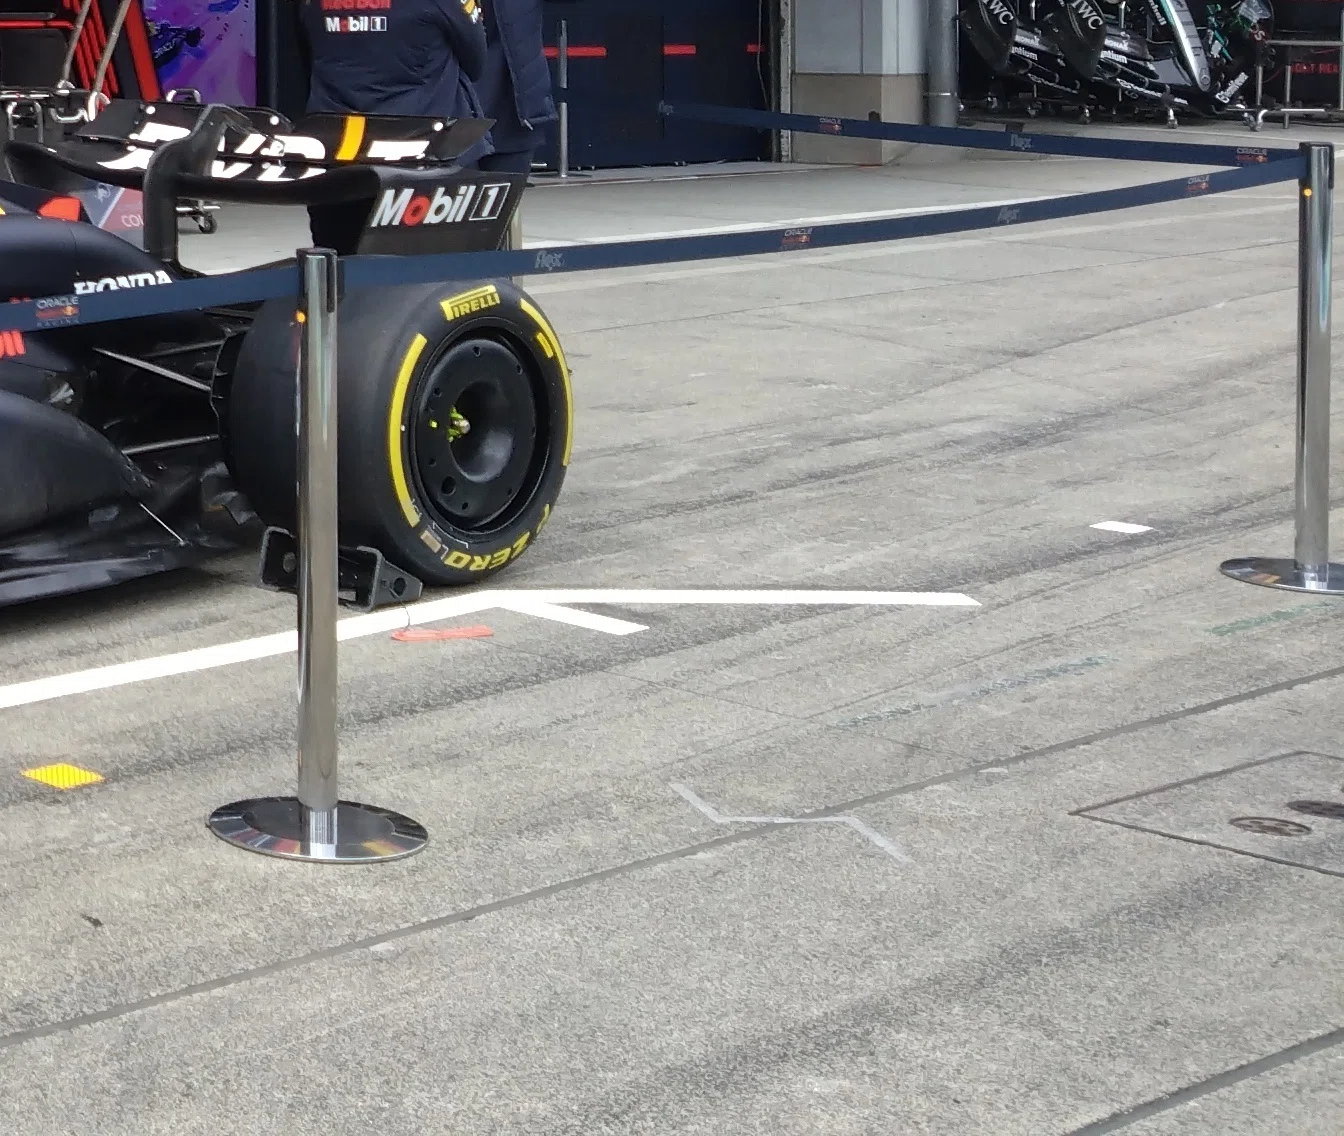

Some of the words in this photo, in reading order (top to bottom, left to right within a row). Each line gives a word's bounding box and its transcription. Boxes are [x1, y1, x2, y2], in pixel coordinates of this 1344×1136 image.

[325, 16, 369, 32] Mobil
[369, 184, 476, 229] Mobil
[37, 296, 79, 310] ORACLE
[439, 284, 501, 322] PIRELLI
